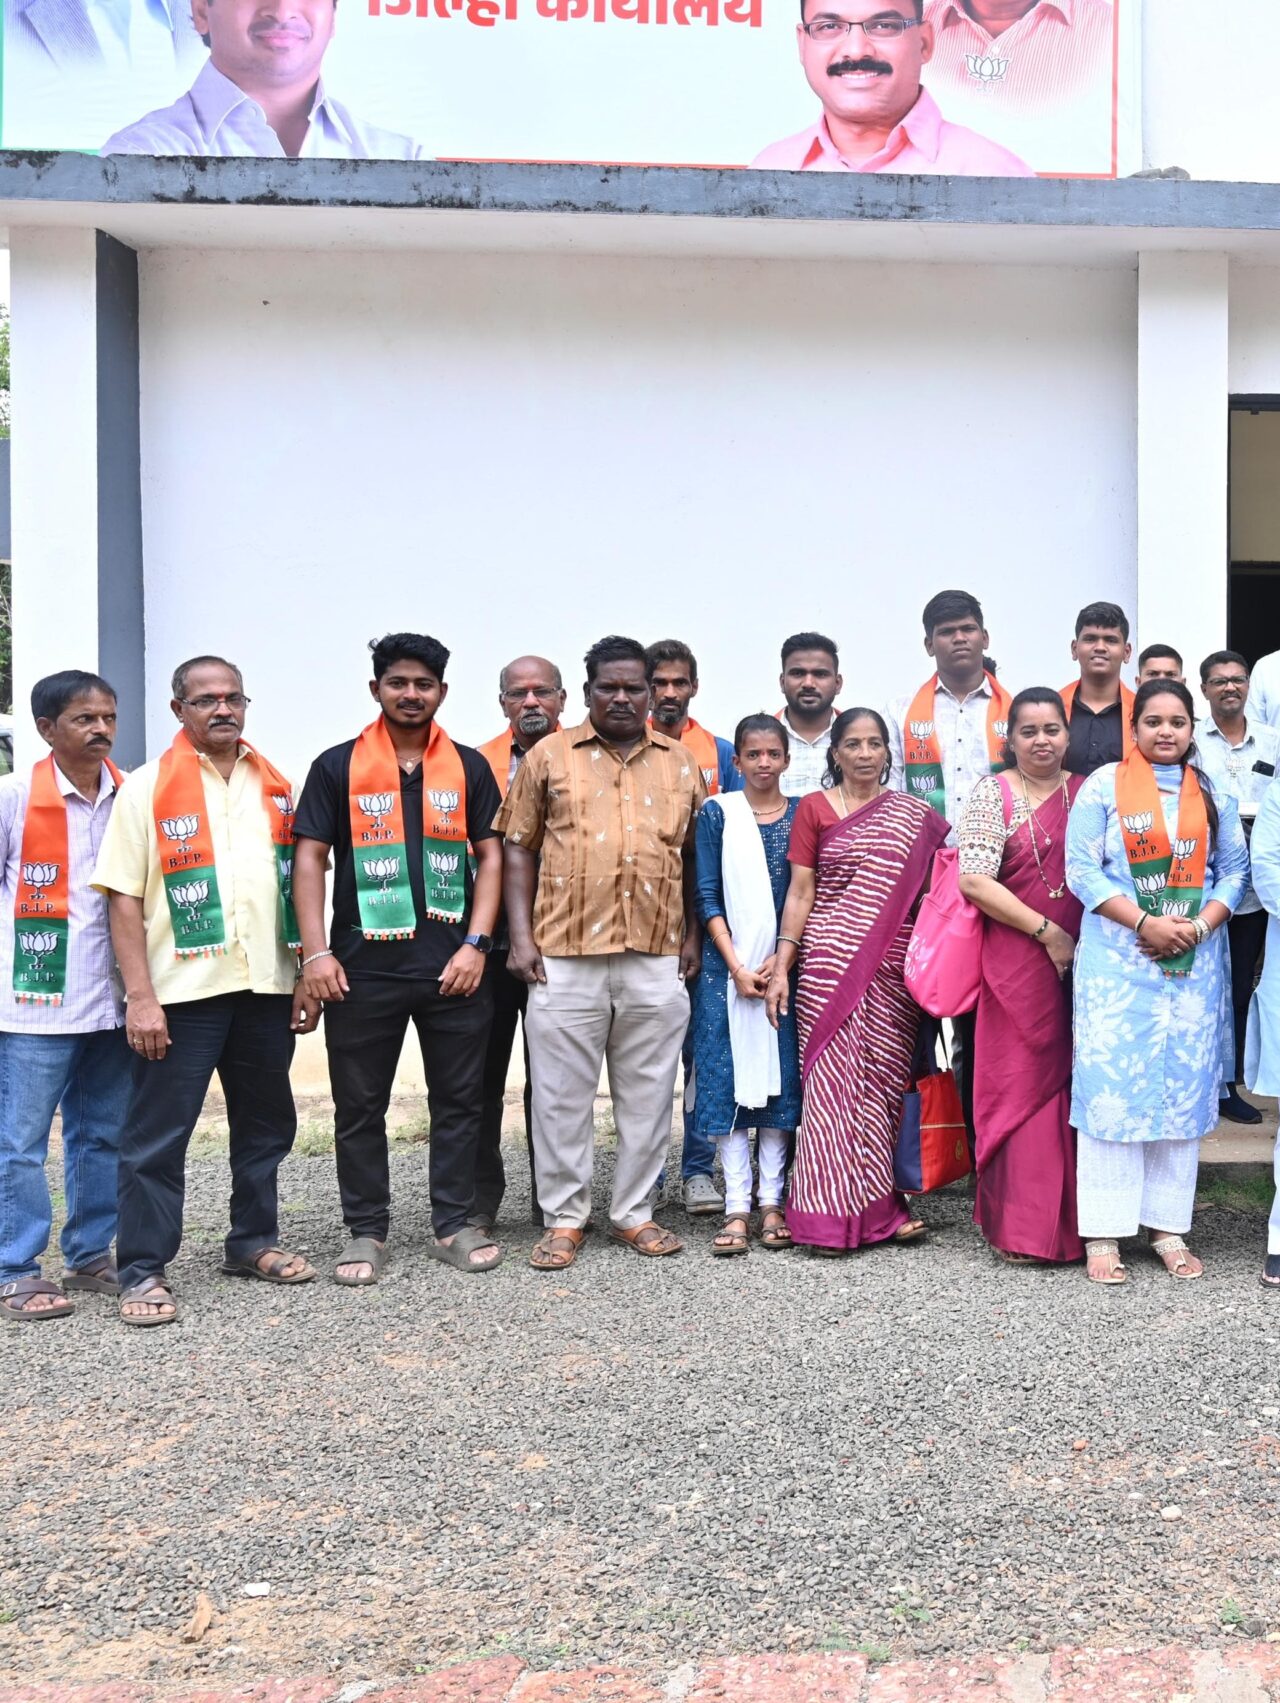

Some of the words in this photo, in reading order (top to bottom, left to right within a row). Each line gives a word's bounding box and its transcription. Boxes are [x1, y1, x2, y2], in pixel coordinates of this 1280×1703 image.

[361, 829, 394, 842] B.J.P.
[1130, 845, 1159, 859] B.J.P.
[168, 852, 204, 868] B.J.P.
[20, 903, 56, 914] B.J.P.
